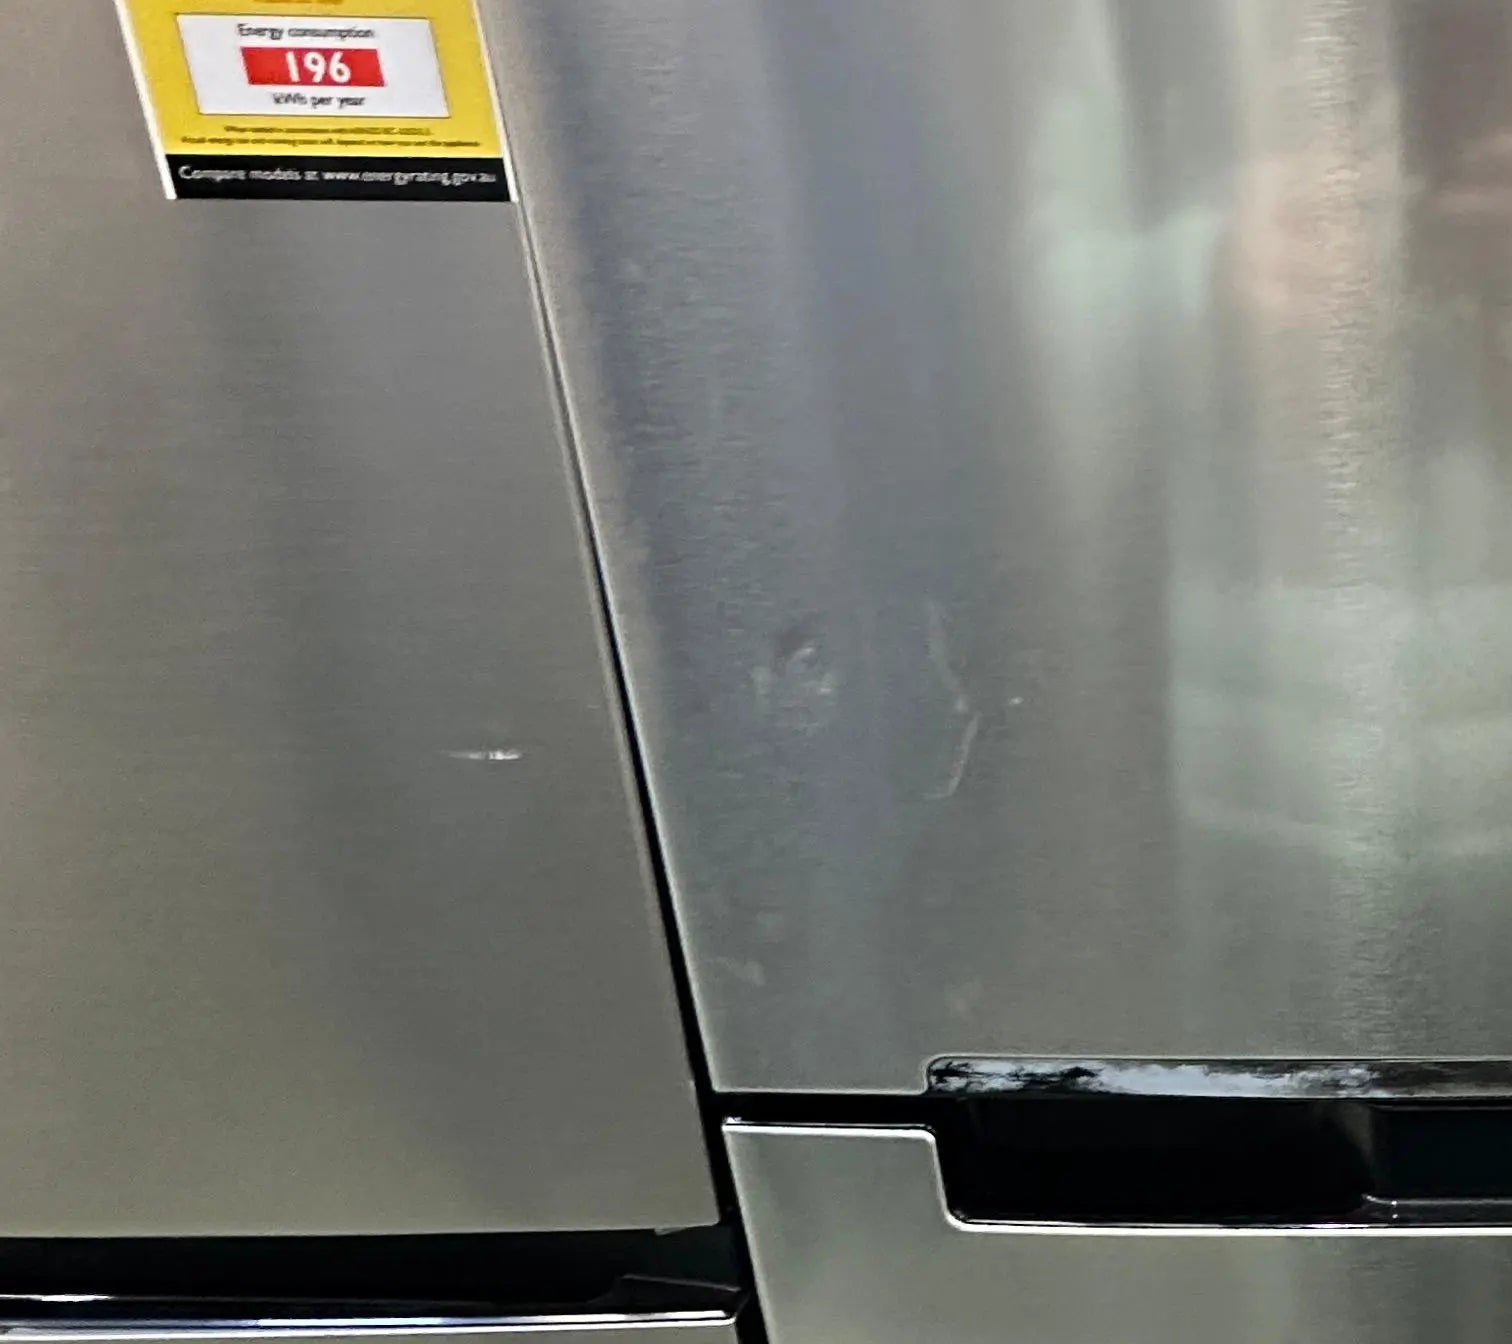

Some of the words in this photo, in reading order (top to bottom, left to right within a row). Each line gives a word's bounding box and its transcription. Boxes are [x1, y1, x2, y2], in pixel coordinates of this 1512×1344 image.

[238, 23, 284, 40] Energy
[286, 51, 351, 83] 196
[310, 96, 334, 109] per
[336, 96, 366, 109] year
